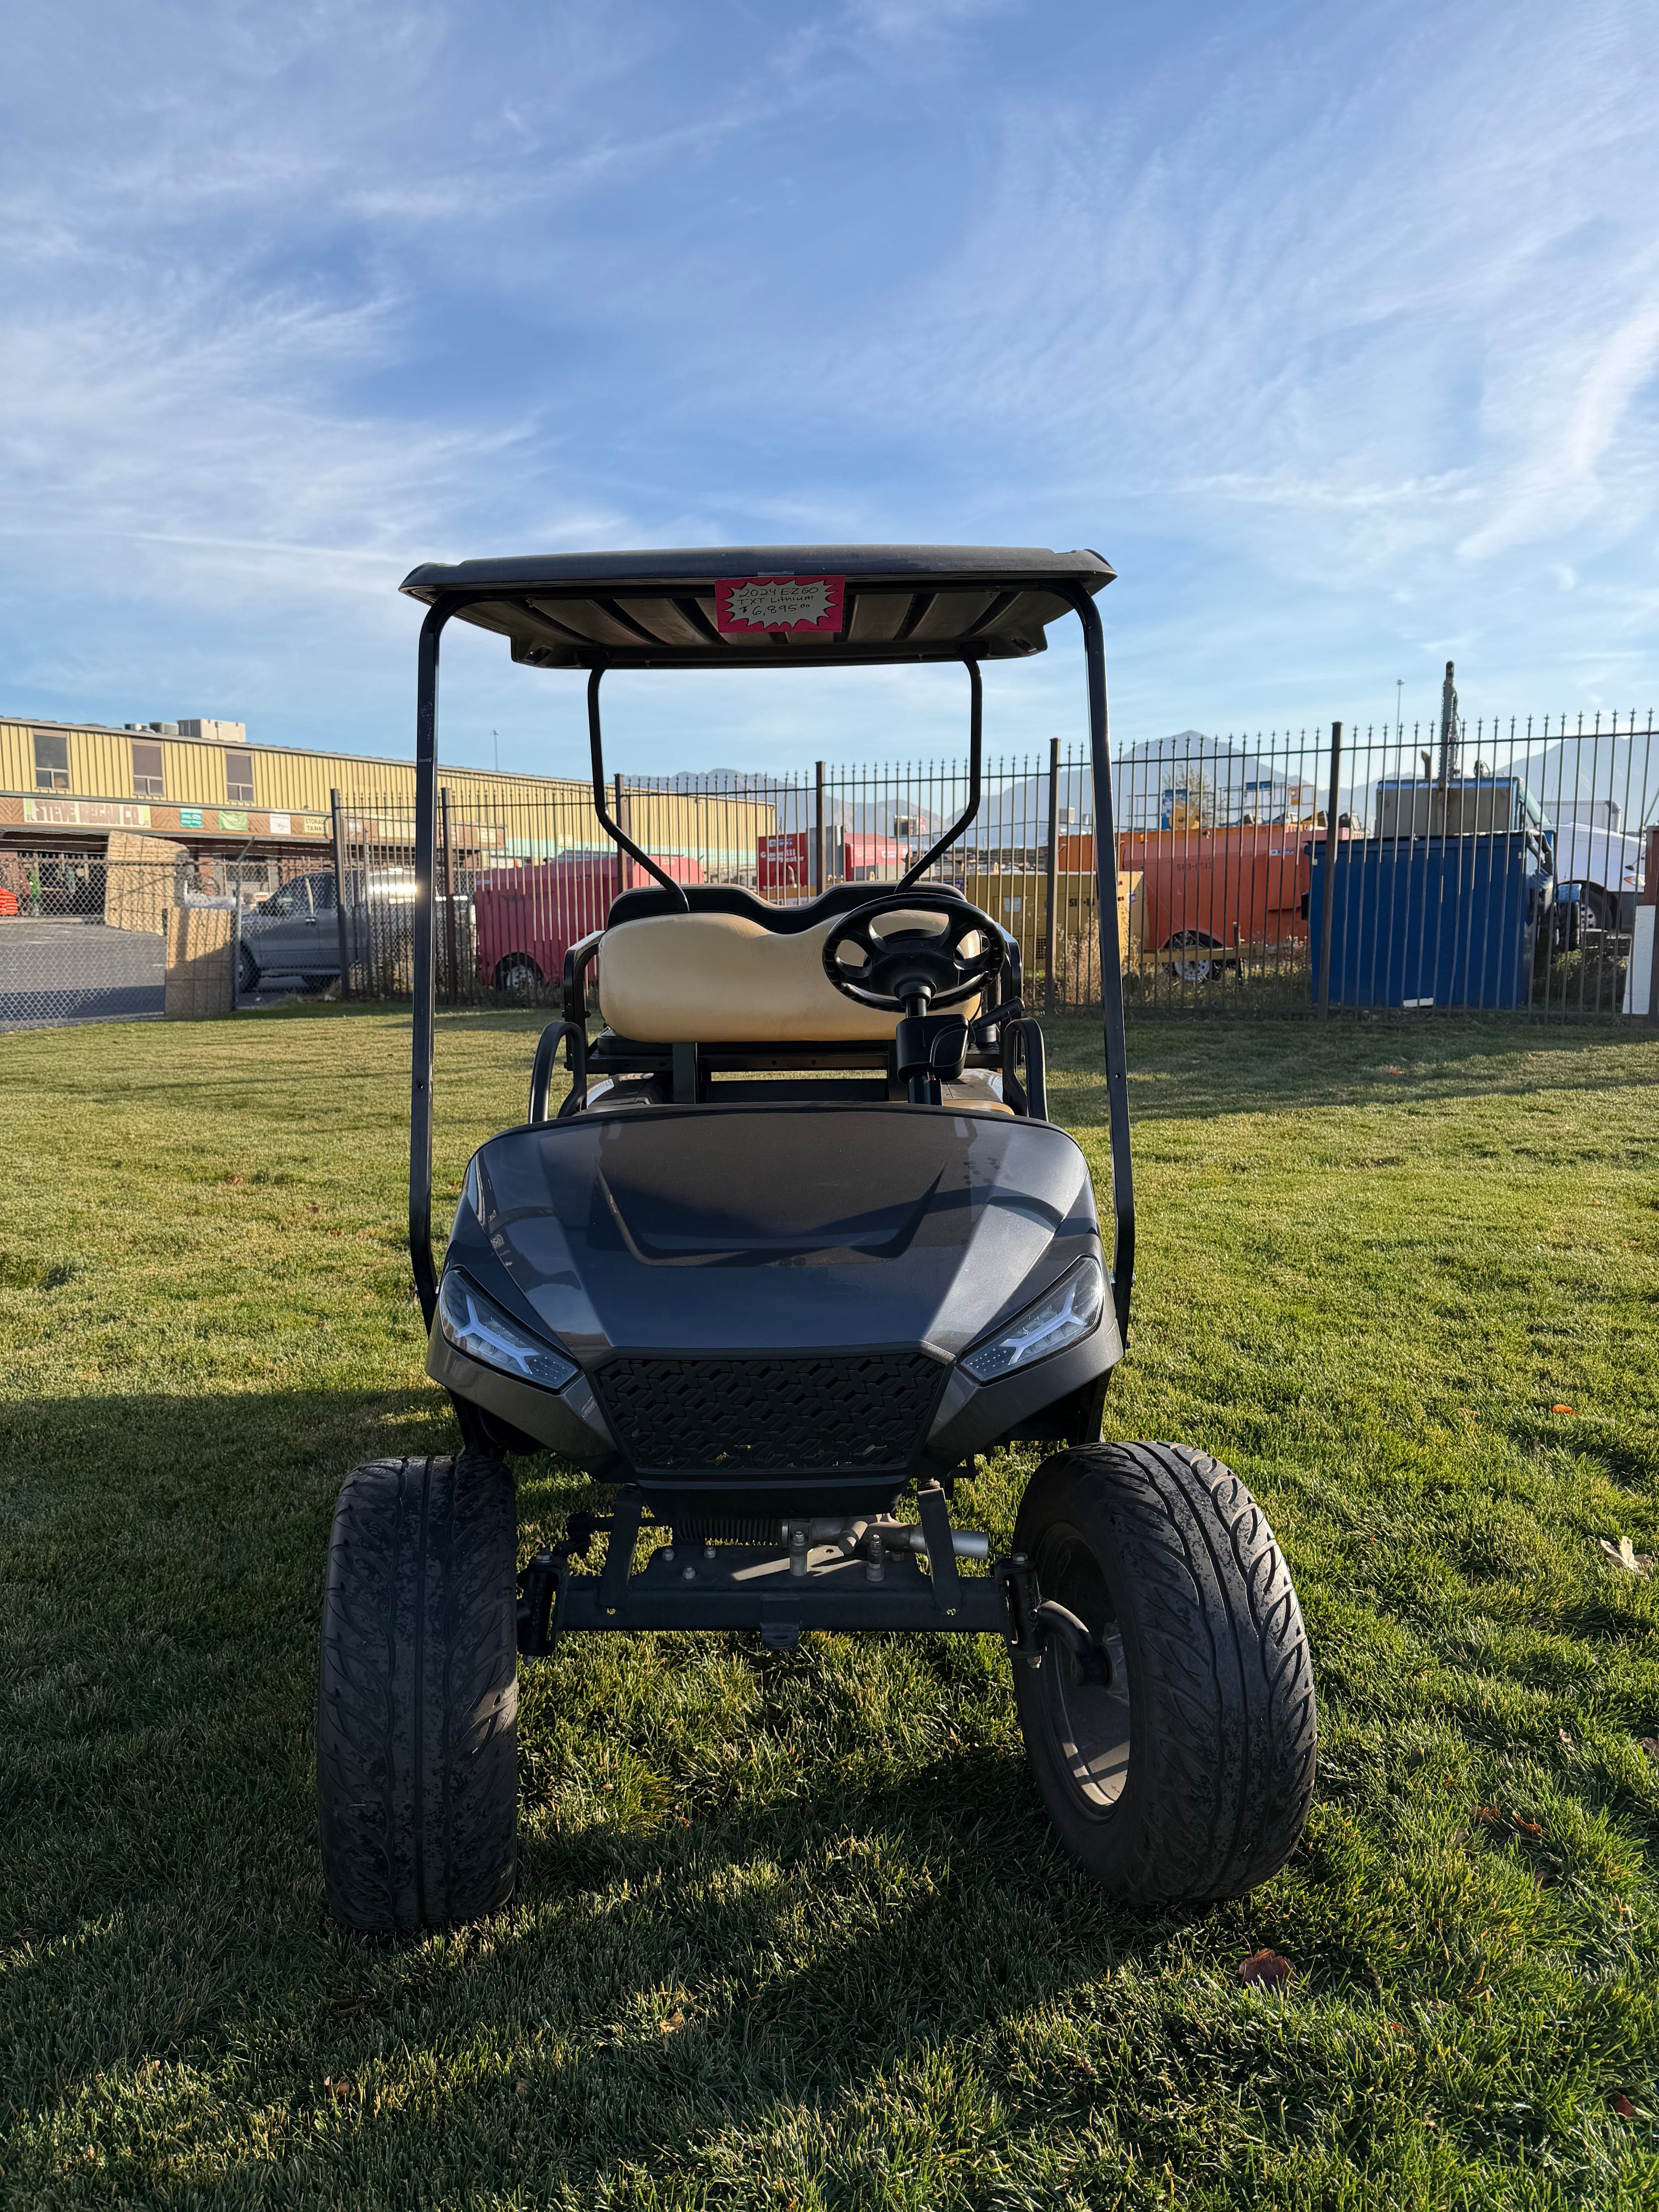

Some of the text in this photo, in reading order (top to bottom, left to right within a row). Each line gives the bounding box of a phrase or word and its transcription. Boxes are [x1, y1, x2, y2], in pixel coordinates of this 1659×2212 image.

[739, 588, 776, 597] 2024
[35, 800, 76, 823] STEVE
[79, 803, 121, 825] REGAN
